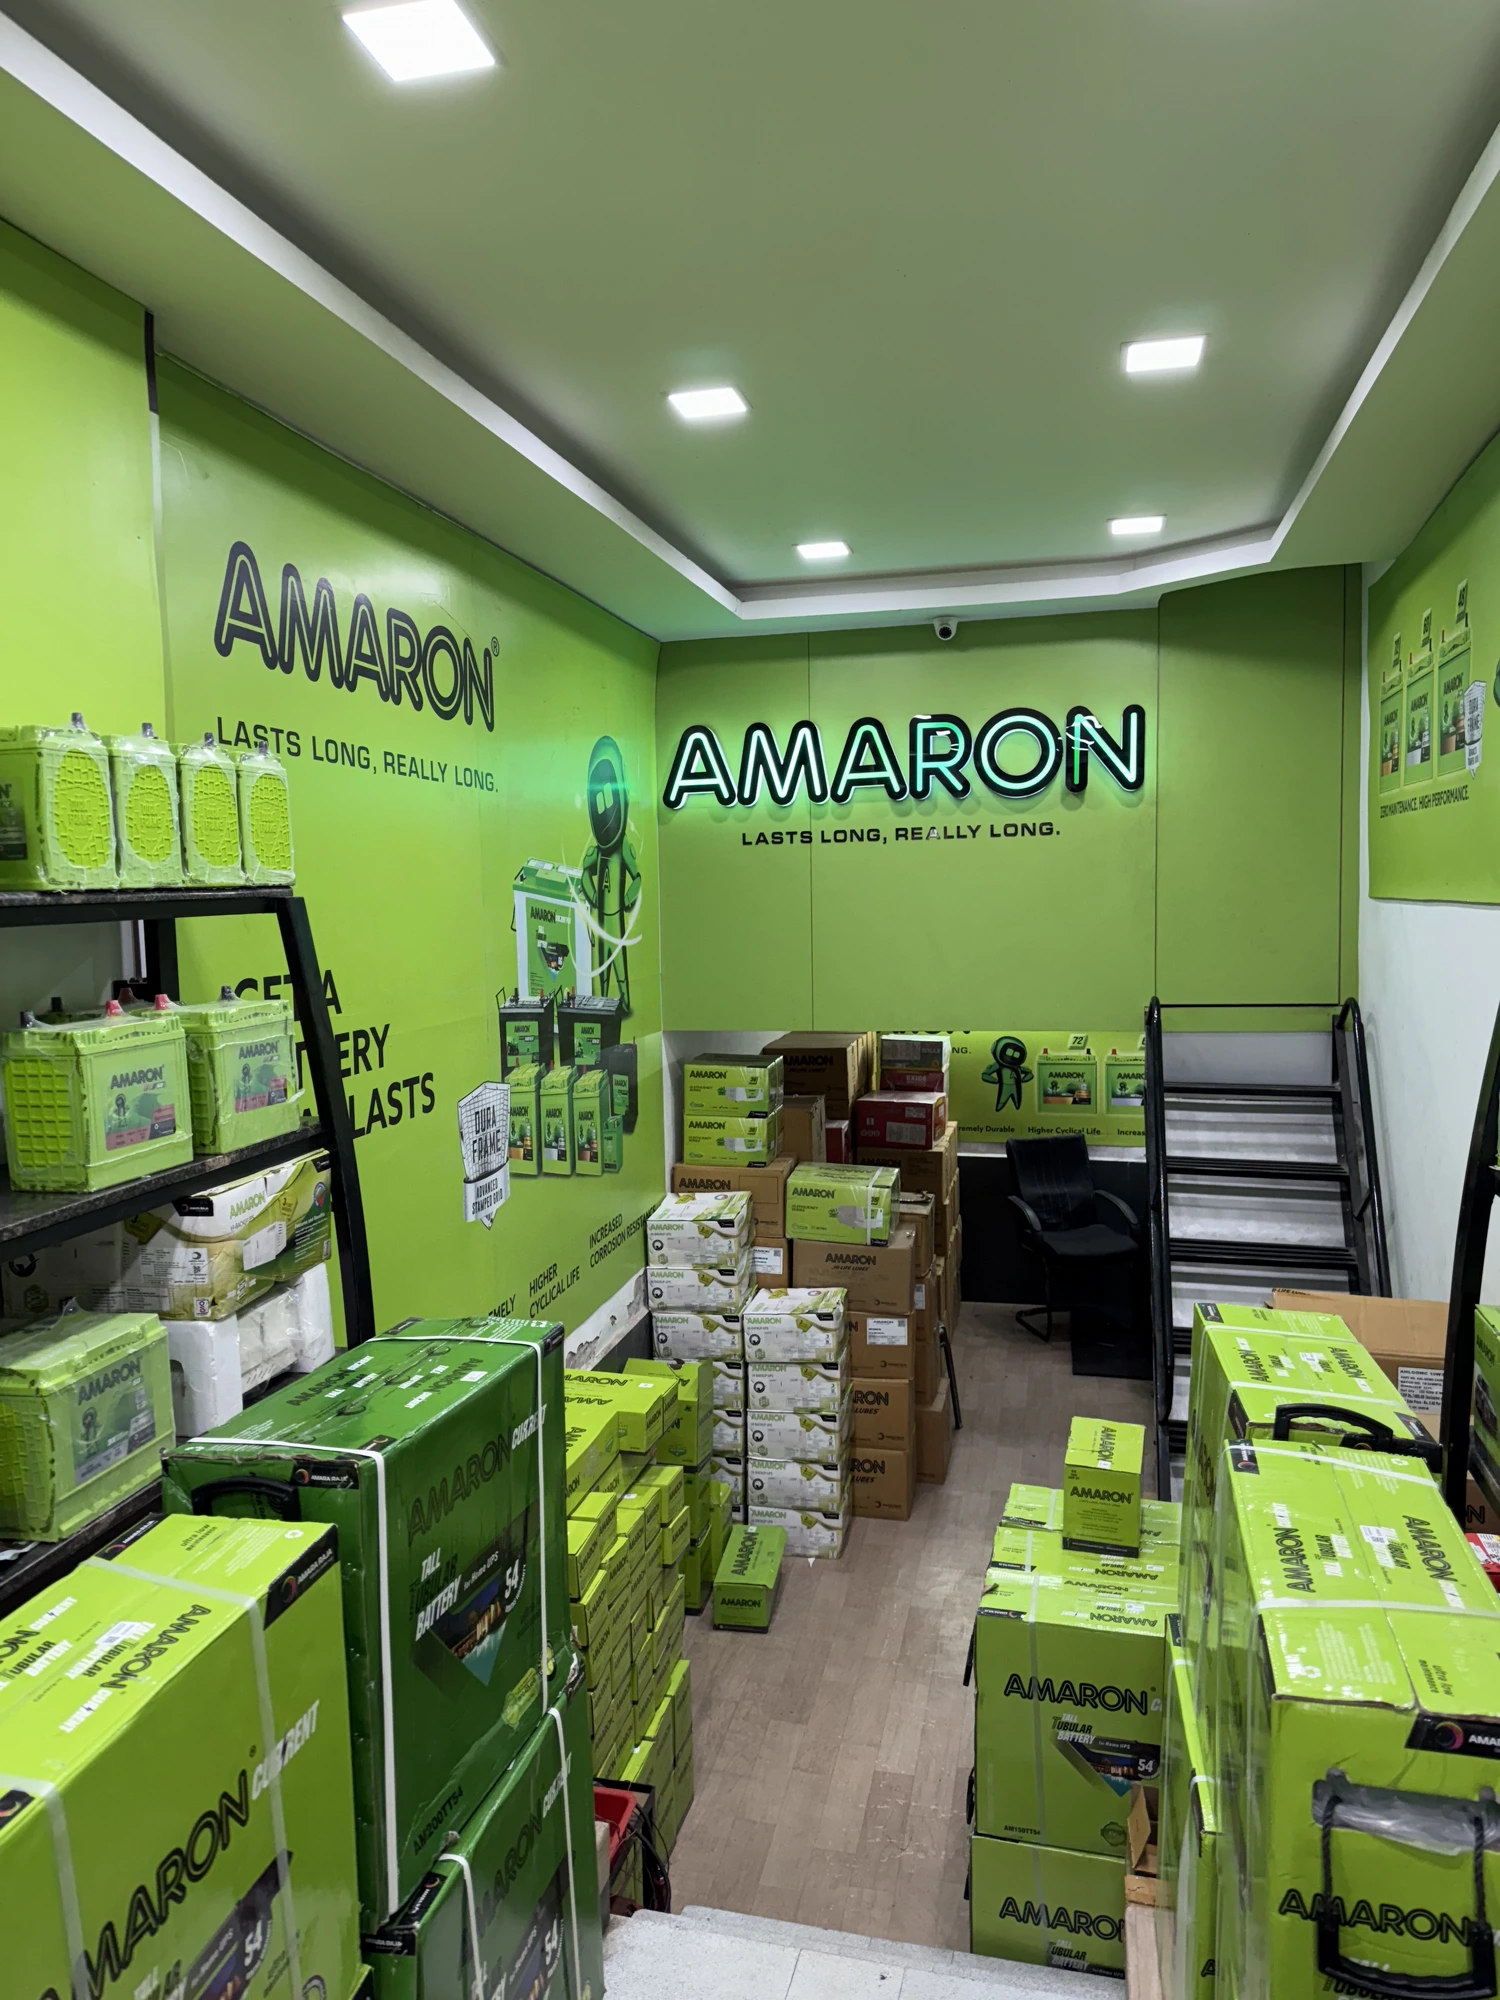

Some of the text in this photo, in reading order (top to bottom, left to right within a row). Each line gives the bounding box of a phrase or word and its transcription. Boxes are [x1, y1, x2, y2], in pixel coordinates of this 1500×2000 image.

[217, 717, 499, 793] LASTS LONG, REALLY LONG.
[664, 704, 1145, 809] AMARON
[742, 822, 1060, 846] LASTS LONG, REALLY LONG.
[238, 1040, 280, 1060] AMARON
[1072, 1036, 1085, 1044] 72
[784, 1055, 833, 1066] AMARON
[110, 1065, 165, 1089] AMARON
[689, 1070, 727, 1079] AMARON
[349, 1072, 436, 1140] LASTS
[475, 1104, 497, 1132] DURA
[689, 1121, 726, 1130] AMARON
[986, 1126, 1015, 1134] Durable
[1028, 1127, 1054, 1136] Higher
[473, 1130, 501, 1163] FRAME
[679, 1178, 731, 1190] AMARON
[792, 1187, 836, 1199] AMARON
[229, 1190, 266, 1219] AMARON
[589, 1213, 622, 1249] INCREASED
[649, 1223, 684, 1231] AMARON
[589, 1231, 626, 1268] CORROSION
[825, 1253, 876, 1265] AMARON
[529, 1263, 558, 1297] HIGHER
[650, 1271, 684, 1279] AMARON
[529, 1266, 580, 1319] CYCLICAL LIFE
[655, 1316, 688, 1324] AMARON
[747, 1317, 782, 1325] AMARON
[422, 1357, 483, 1393] AMARON
[752, 1364, 787, 1372] AMARON
[1237, 1349, 1272, 1384] AMARON
[1327, 1346, 1368, 1380] AMARON
[78, 1356, 142, 1406] AMARON
[286, 1368, 355, 1406] AMARON
[647, 1408, 661, 1429] AMARON
[751, 1413, 785, 1421] AMARON
[751, 1461, 786, 1470] AMARON
[408, 1433, 511, 1547] AMARON
[1070, 1486, 1132, 1504] AMARON
[751, 1510, 787, 1519] AMARON
[123, 1529, 144, 1545] AMARA
[180, 1523, 211, 1548] ultra low
[672, 1521, 688, 1545] AMARON
[580, 1540, 598, 1572] AMARON
[730, 1530, 760, 1577] AMARON
[1273, 1527, 1316, 1594] AMARON
[1402, 1514, 1458, 1582] AMARON
[297, 1564, 320, 1584] AMARA
[316, 1548, 333, 1571] RAJA
[421, 1547, 441, 1582] TALL
[470, 1561, 488, 1584] Home
[486, 1551, 499, 1572] UPS
[609, 1555, 629, 1581] AMARON
[1095, 1568, 1159, 1580] AMARON
[505, 1559, 520, 1599] 54
[1064, 1581, 1129, 1592] AMARON
[415, 1575, 462, 1642] BATTERY
[589, 1588, 606, 1625] AMARON
[720, 1599, 762, 1608] AMARON
[1090, 1612, 1158, 1627] AMARON
[100, 1604, 212, 1689] AMARON
[592, 1626, 610, 1664] AMARON
[1432, 1664, 1454, 1698] ultra low
[1003, 1673, 1148, 1715] AMARON
[1051, 1716, 1093, 1735] TUBULAR
[1062, 1713, 1079, 1722] TALL
[1057, 1731, 1096, 1745] BATTERY
[1137, 1758, 1154, 1773] 54
[244, 1919, 263, 1967] 54
[544, 1918, 558, 1966] 54
[1051, 1957, 1090, 1972] BATTERY
